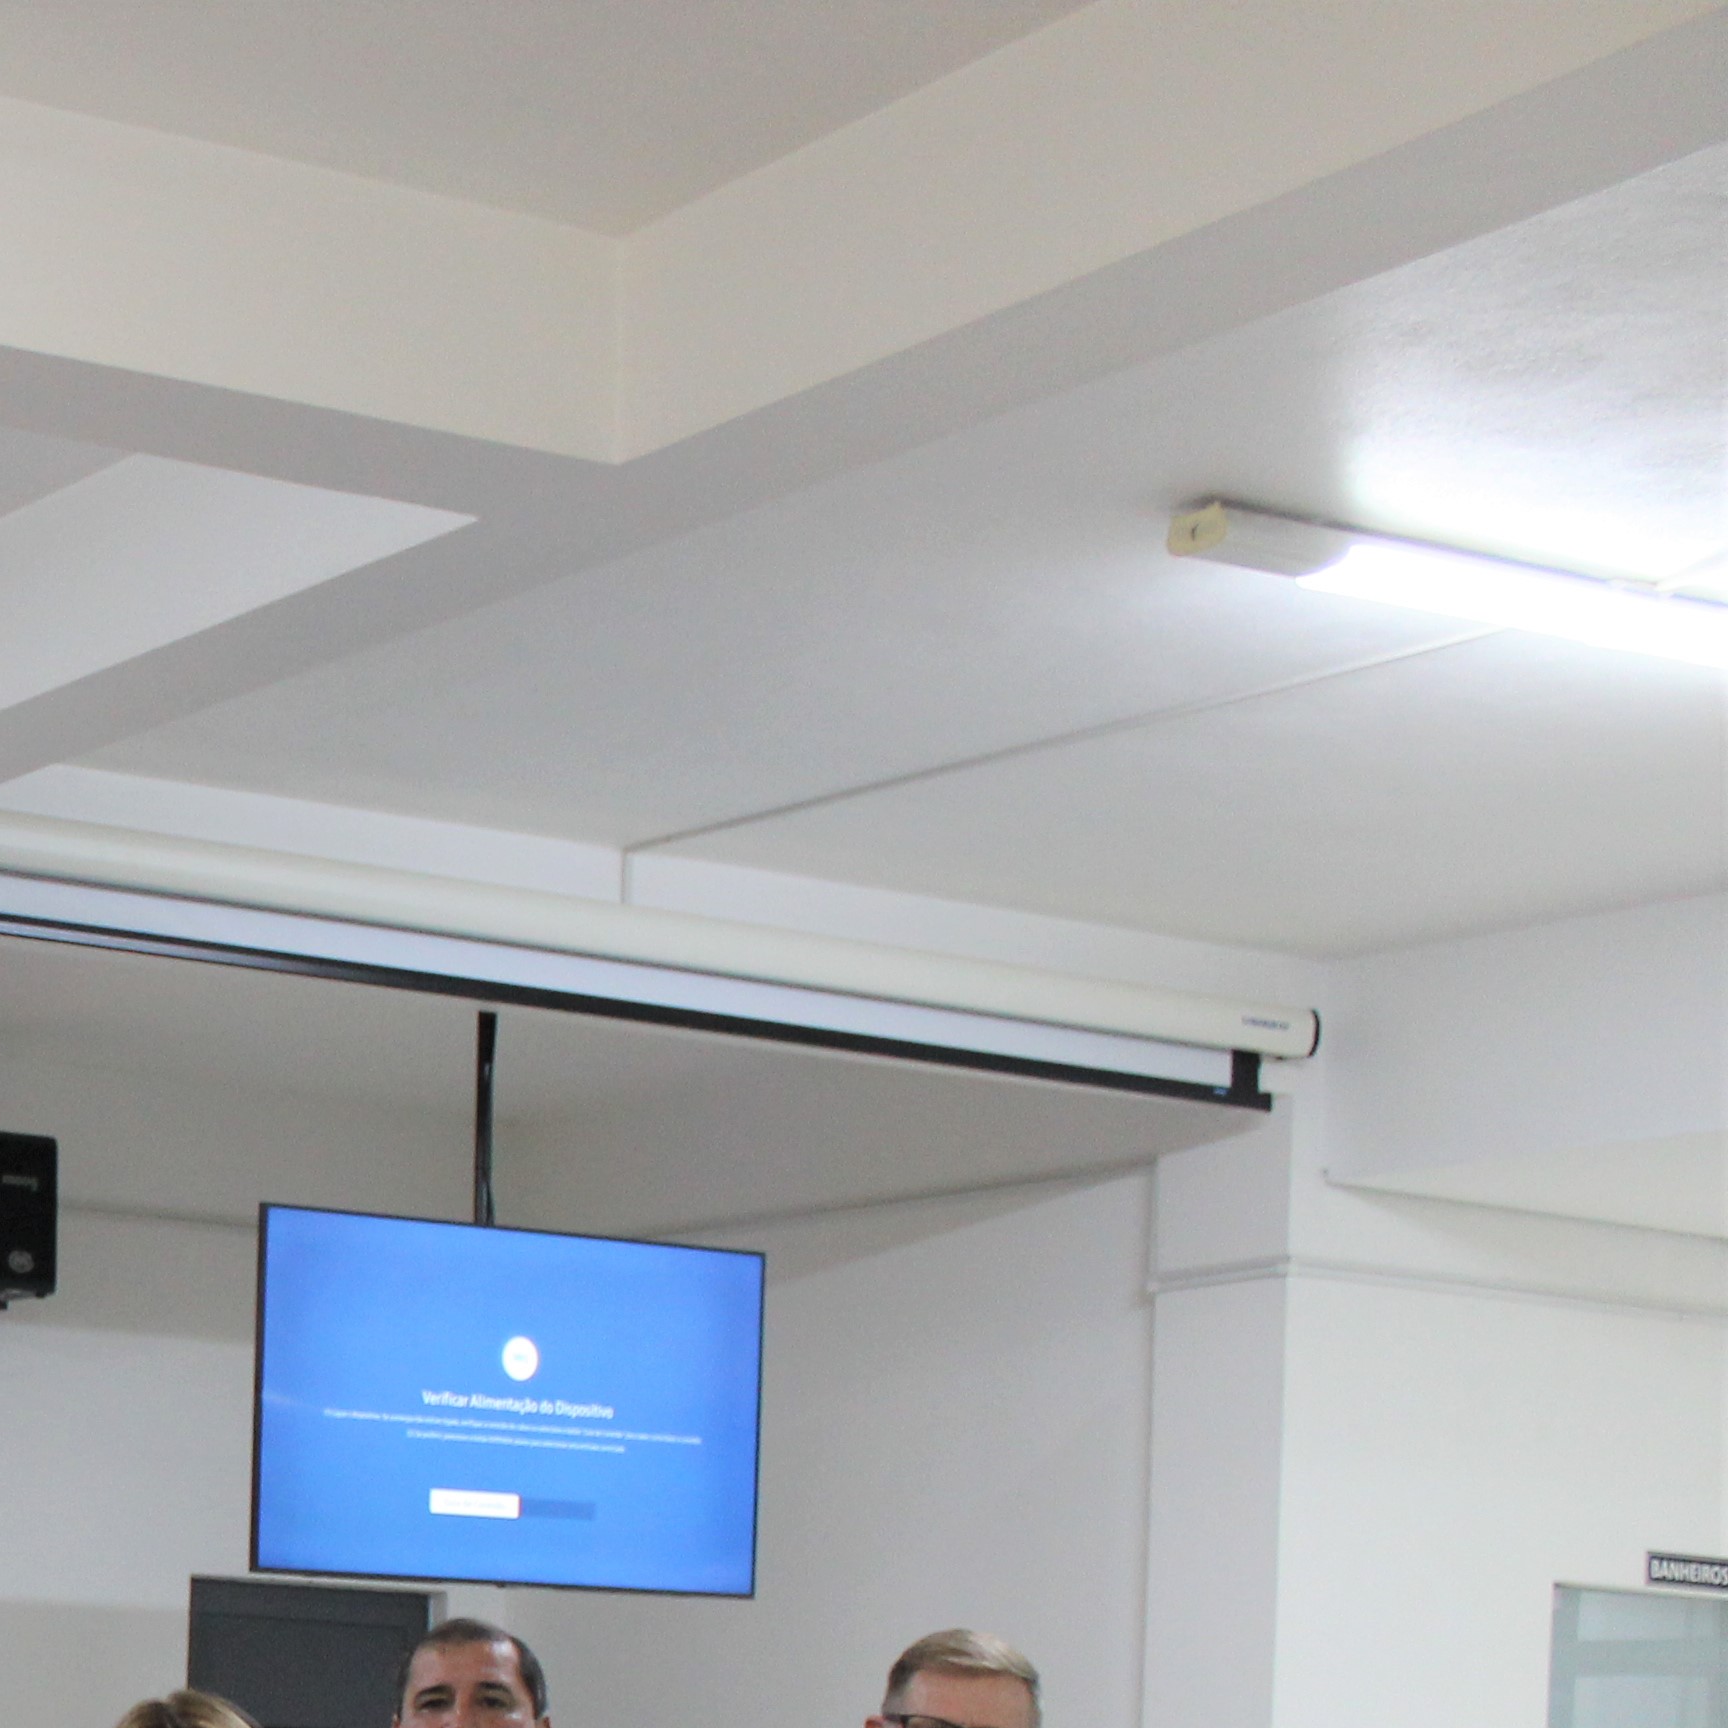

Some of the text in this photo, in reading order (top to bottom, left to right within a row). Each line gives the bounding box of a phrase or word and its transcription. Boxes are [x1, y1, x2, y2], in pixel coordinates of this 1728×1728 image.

[422, 1389, 614, 1420] Verificar Alimentação do Dispositivo
